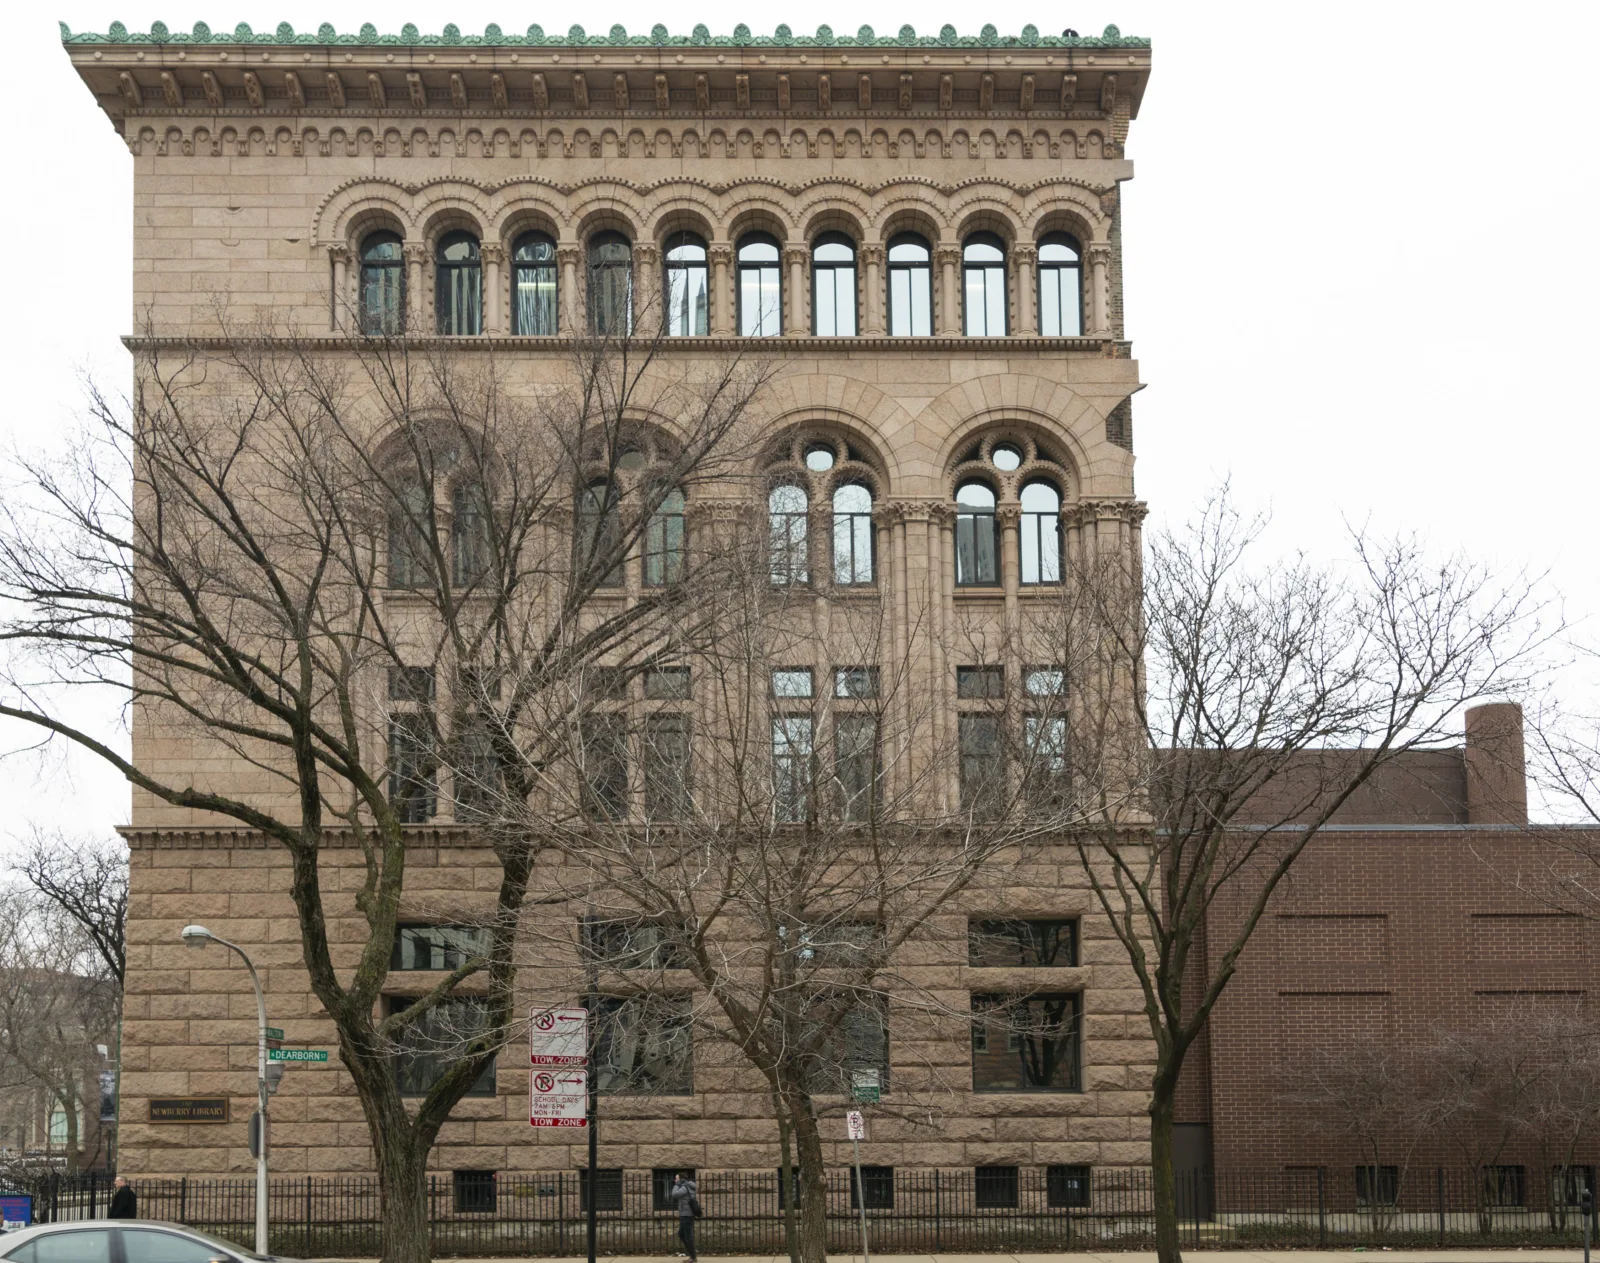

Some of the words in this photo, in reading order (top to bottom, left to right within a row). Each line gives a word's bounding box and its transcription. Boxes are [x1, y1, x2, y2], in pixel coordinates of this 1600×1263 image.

[275, 1050, 320, 1060] DEARBORN
[534, 1056, 554, 1064] TOW
[152, 1107, 190, 1116] NEWBERRY
[192, 1107, 224, 1116] LIBRARY
[534, 1118, 553, 1126] TOW
[557, 1118, 582, 1127] ZONE
